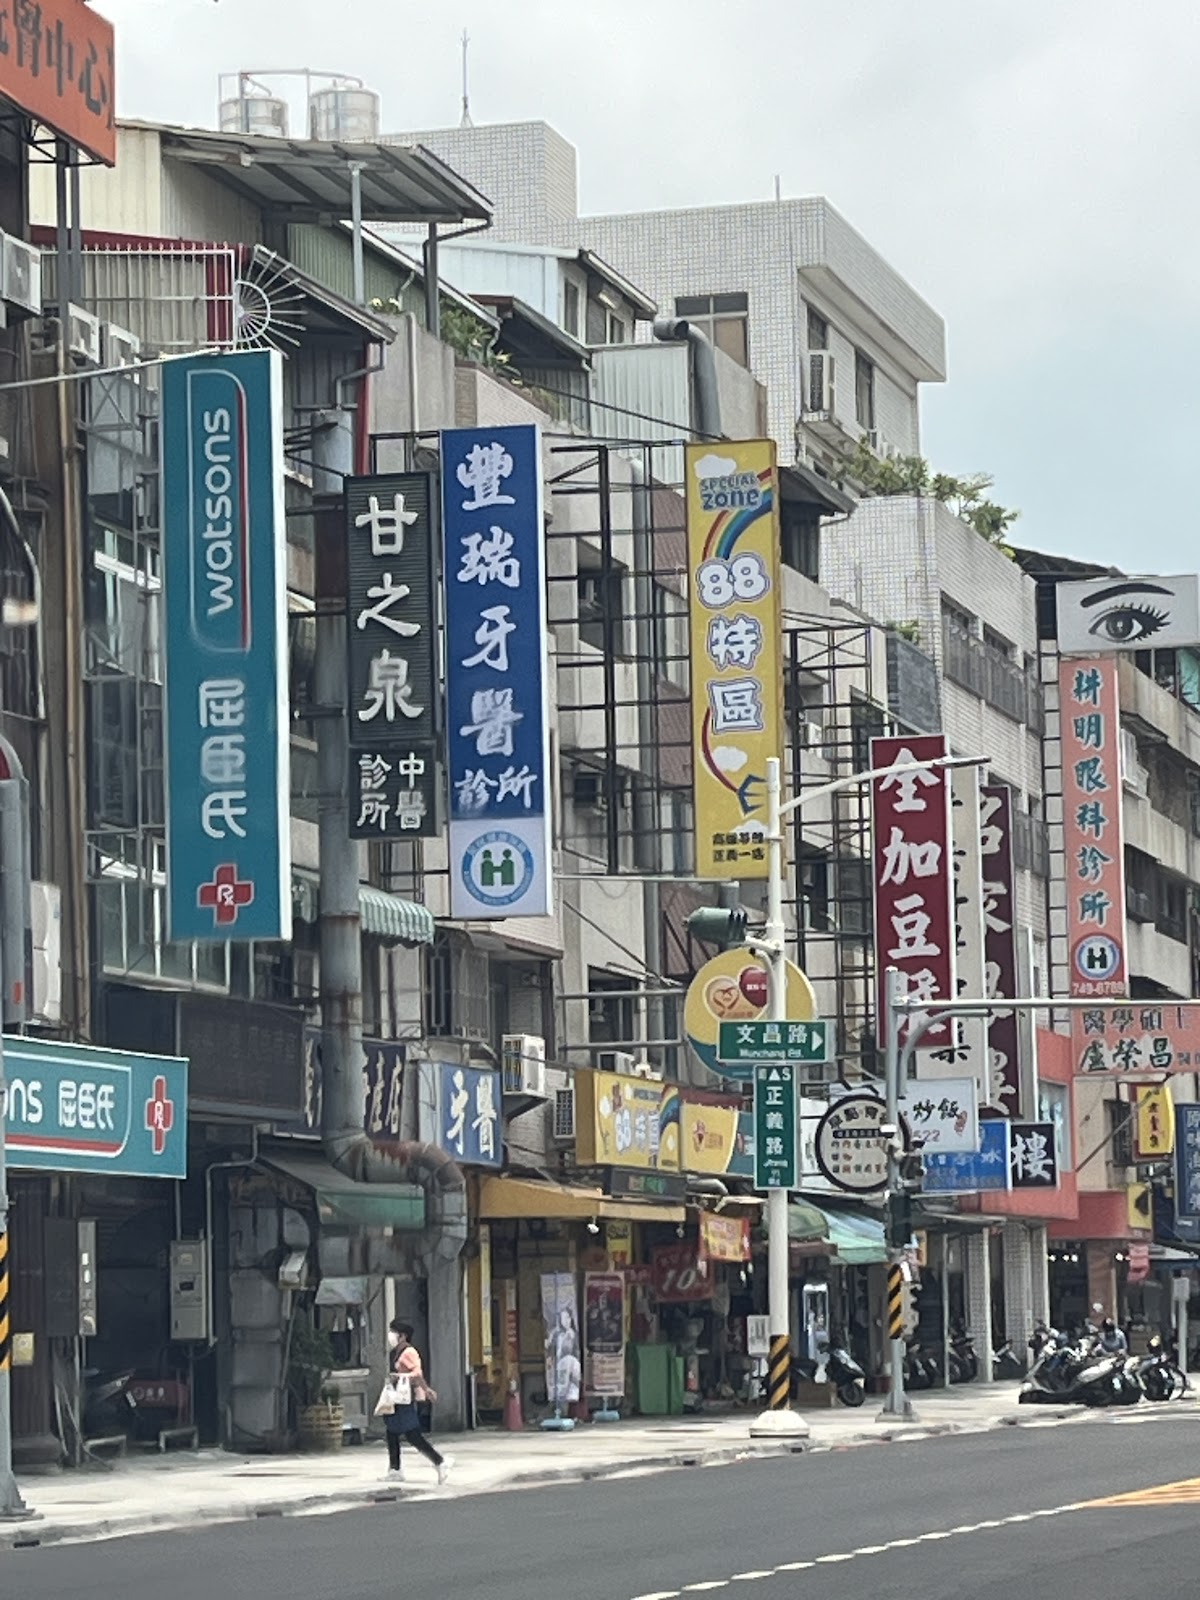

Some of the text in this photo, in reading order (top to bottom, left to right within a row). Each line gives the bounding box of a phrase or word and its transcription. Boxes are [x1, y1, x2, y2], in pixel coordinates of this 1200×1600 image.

[204, 407, 233, 617] watsons
[354, 492, 424, 723] 甘之泉
[199, 678, 246, 838] 屈臣氏
[356, 753, 391, 831] 診所
[395, 751, 427, 831] 中醫
[736, 1024, 808, 1044] 文昌路
